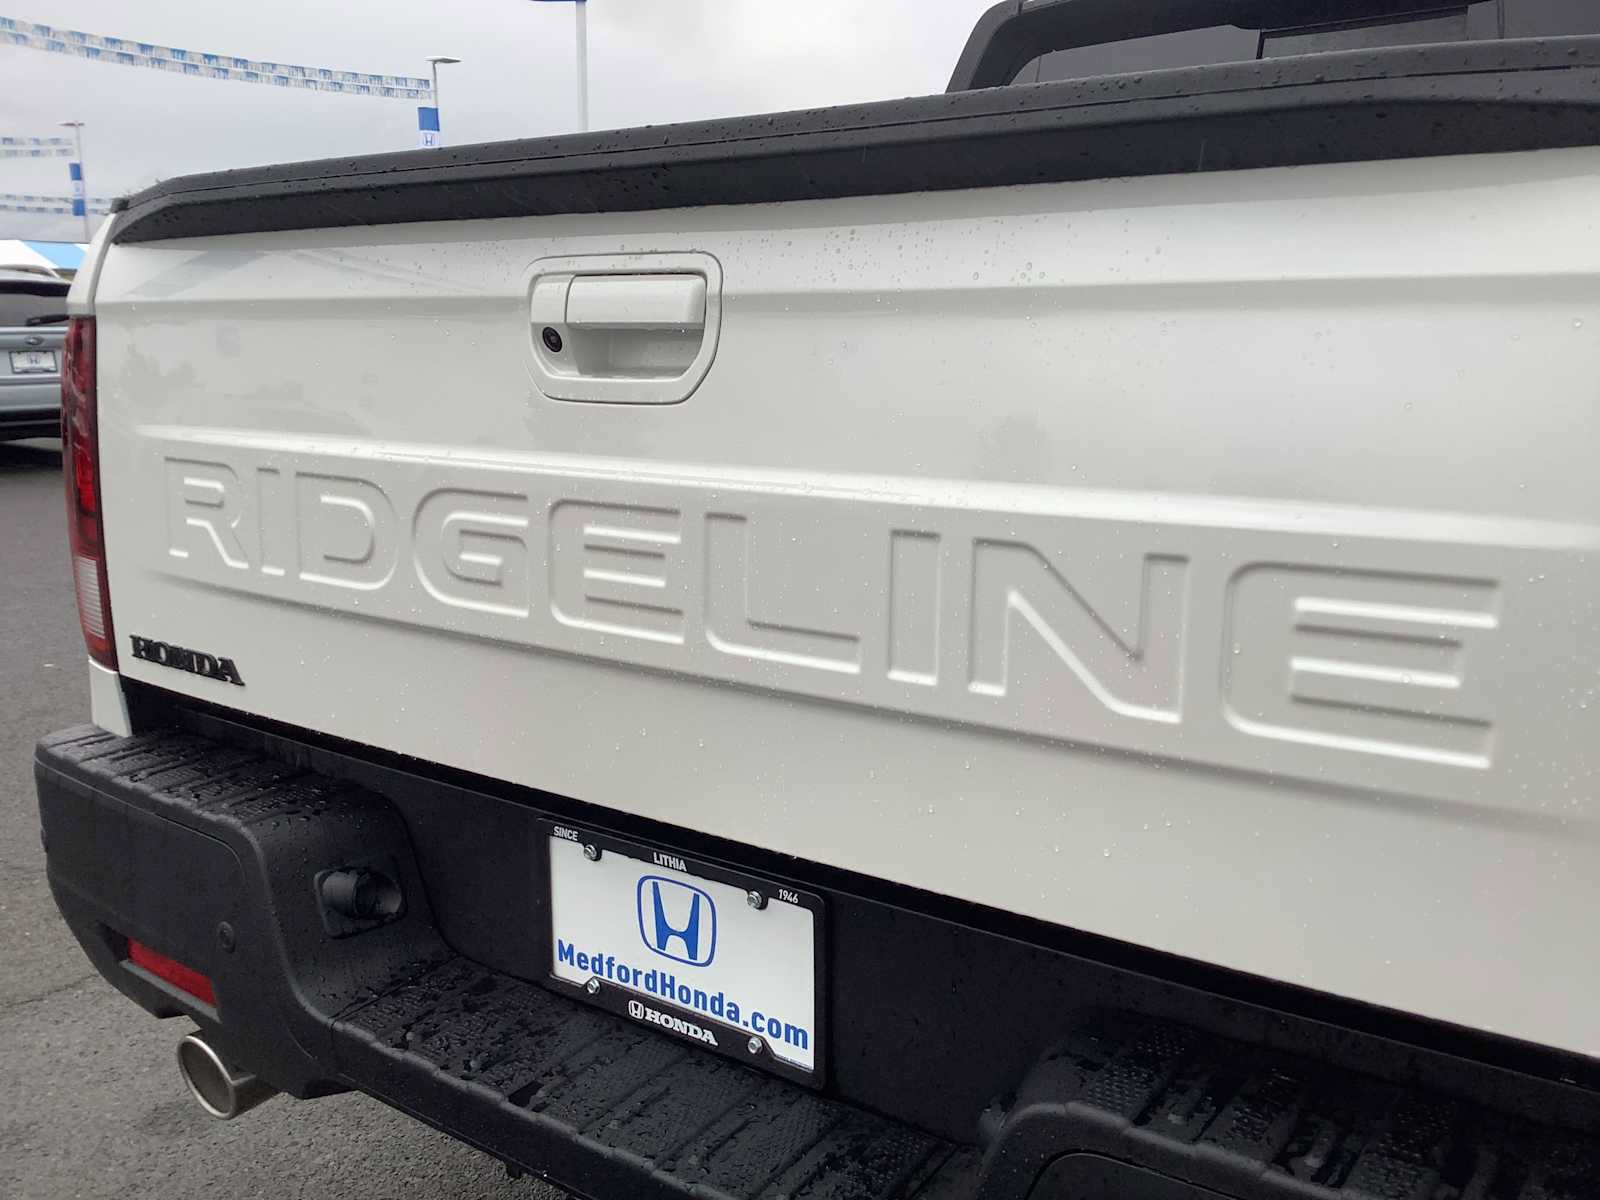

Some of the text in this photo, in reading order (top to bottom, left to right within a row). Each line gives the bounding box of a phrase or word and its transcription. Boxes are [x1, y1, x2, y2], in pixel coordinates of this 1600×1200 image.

[164, 456, 1499, 768] RIDGELINE
[129, 634, 245, 686] HONDA
[553, 826, 799, 904] SINCE LITHIA 1946
[558, 939, 808, 1050] MedfordHonda.com
[644, 1007, 718, 1046] HONDA
